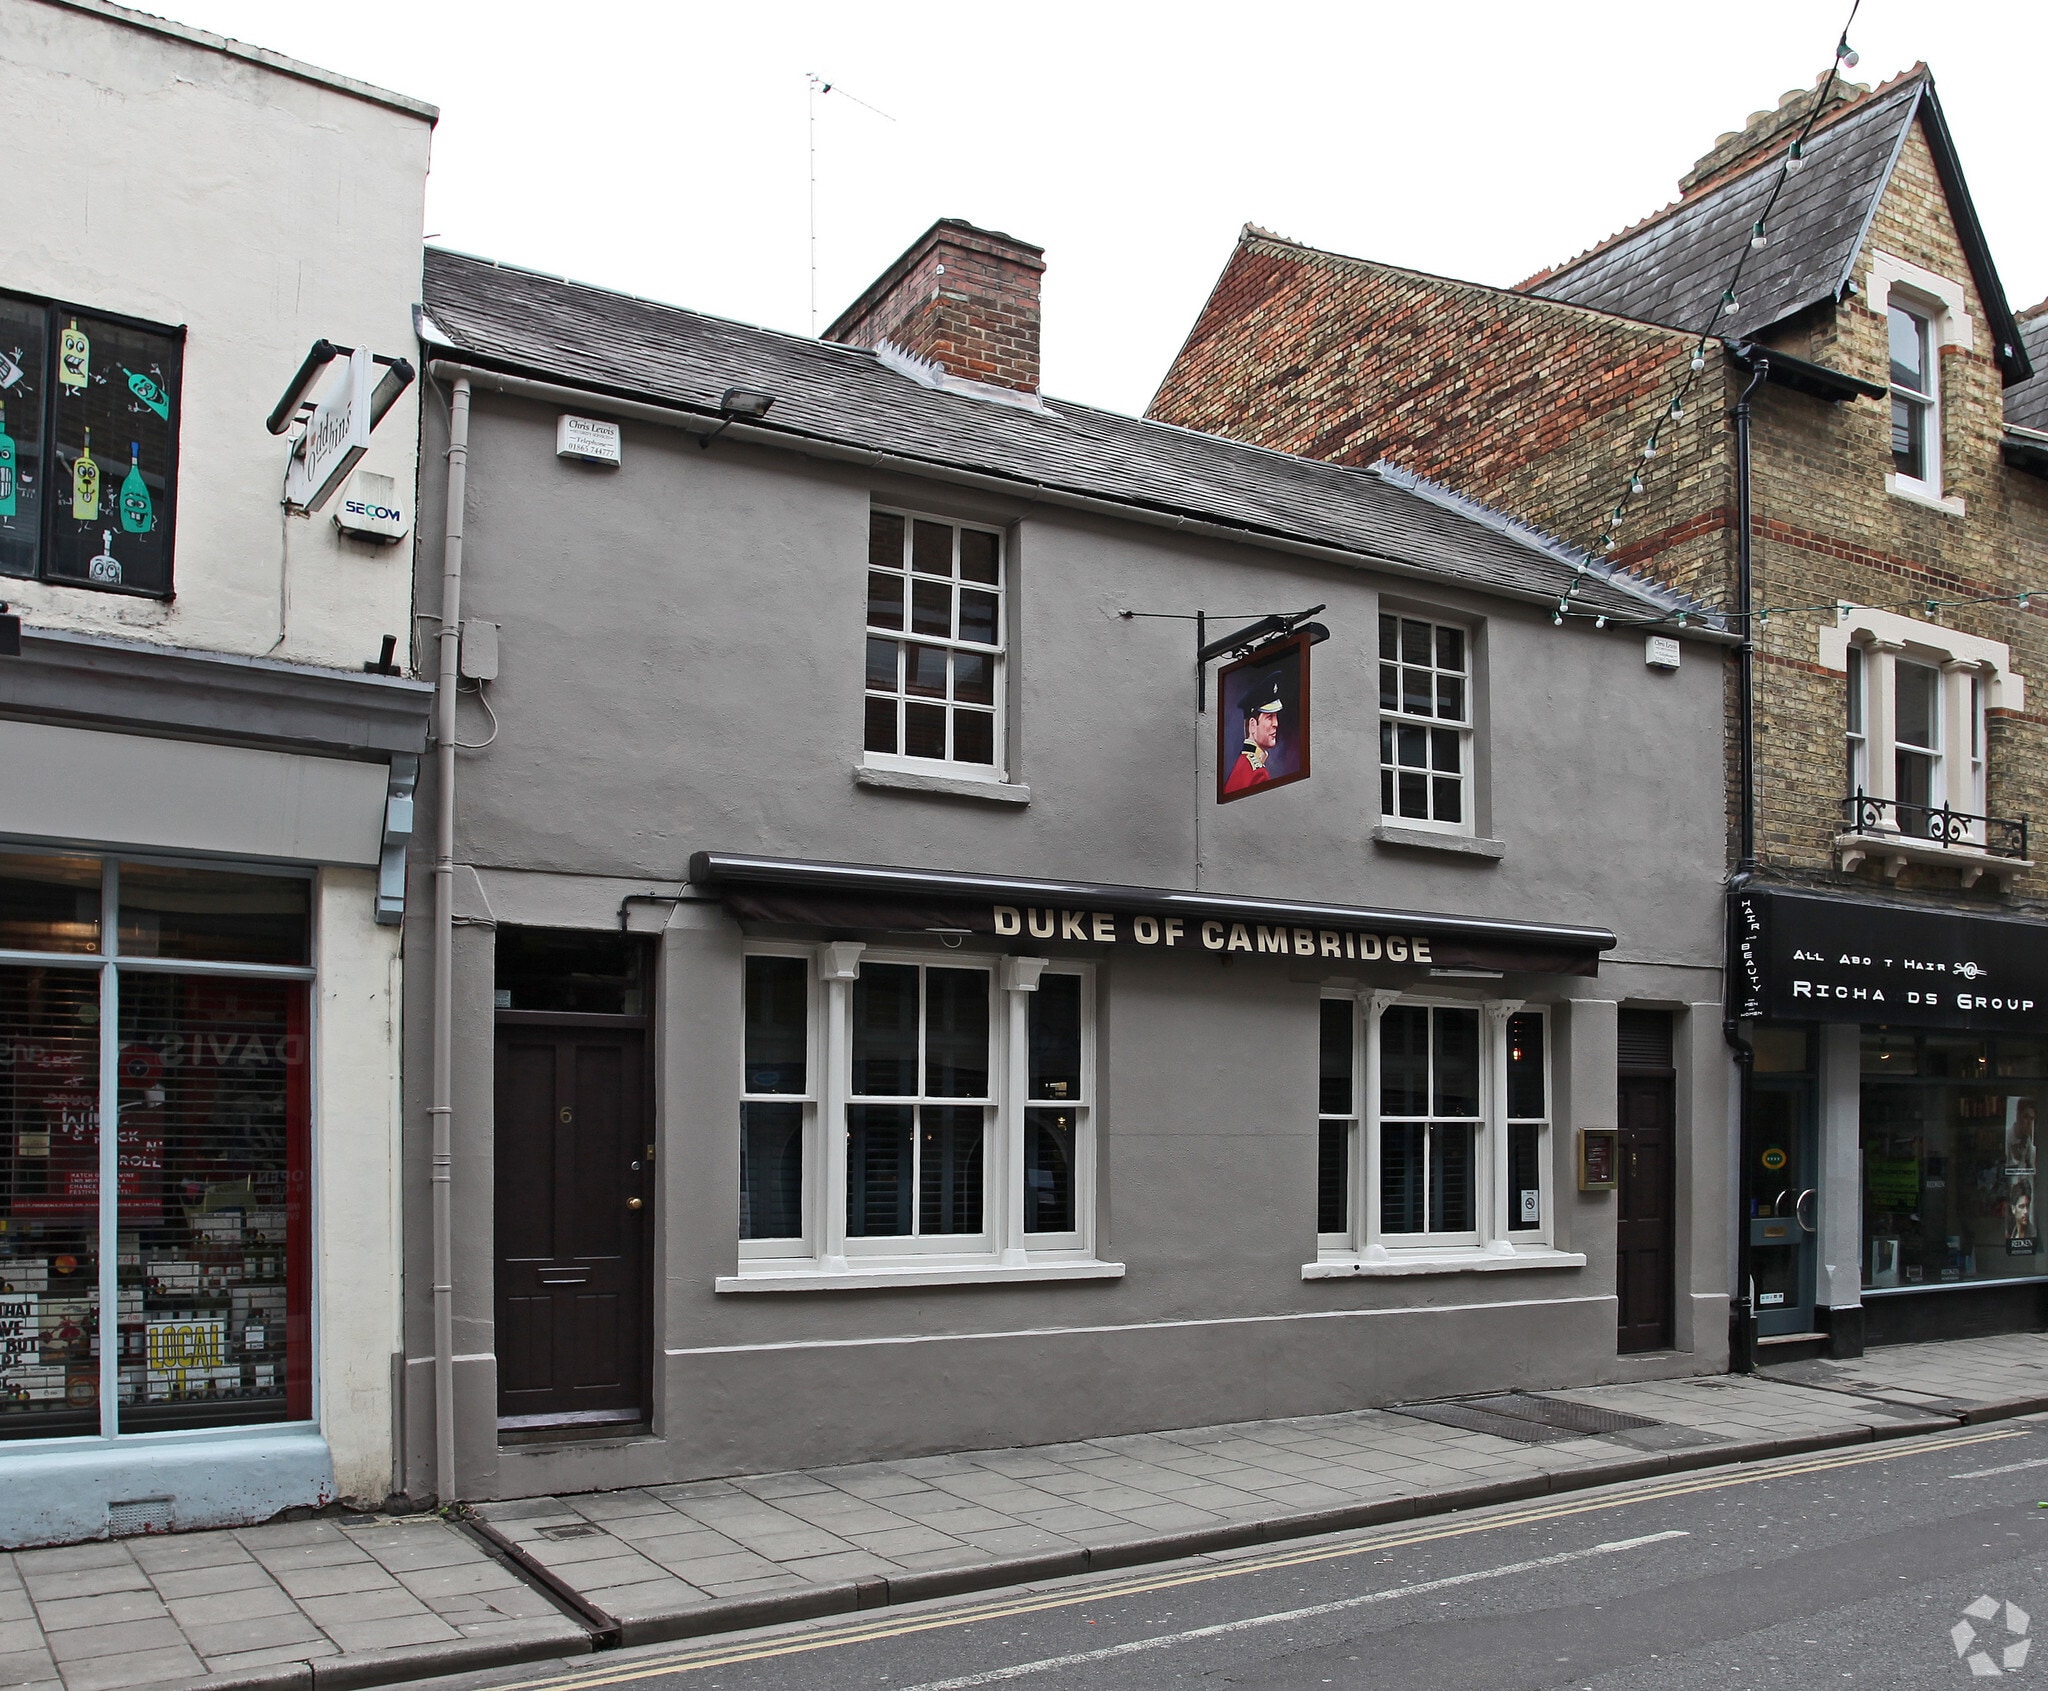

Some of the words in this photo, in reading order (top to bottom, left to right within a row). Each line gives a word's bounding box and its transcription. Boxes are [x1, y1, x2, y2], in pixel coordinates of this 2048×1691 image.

[568, 419, 590, 431] Chris
[591, 424, 615, 436] Lewis
[568, 442, 589, 452] 01865
[590, 446, 615, 457] 744777
[576, 437, 607, 447] Telephone
[345, 500, 401, 522] SECOM
[1741, 899, 1760, 931] HAIR
[993, 905, 1117, 942] DUKE
[1133, 915, 1184, 946] OF
[1202, 920, 1432, 963] CAMBRIDGE
[1741, 943, 1761, 992] BEAUTY
[1904, 959, 1946, 972] HAIR
[1956, 993, 2035, 1012] GROUP
[560, 1106, 572, 1124] 6
[119, 1155, 162, 1168] ROLL
[2011, 1239, 2033, 1248] REDKEN
[6, 1338, 38, 1353] BUT
[149, 1324, 223, 1370] LOCAL
